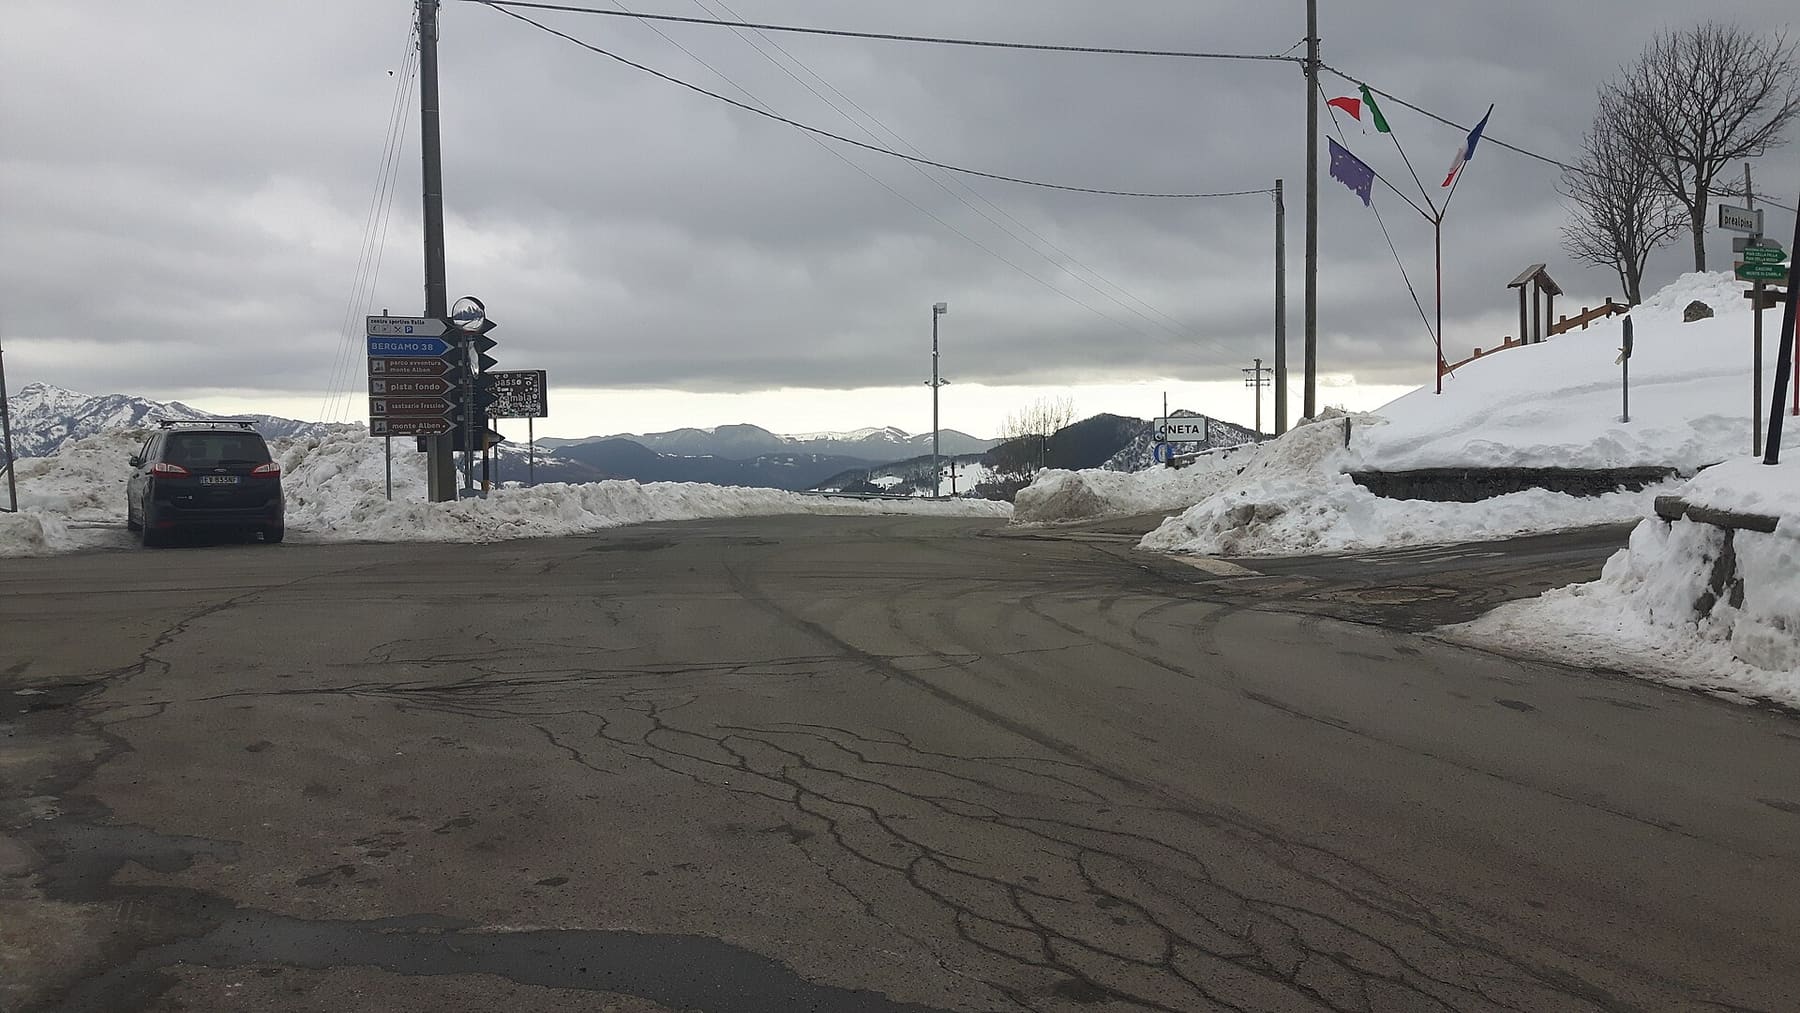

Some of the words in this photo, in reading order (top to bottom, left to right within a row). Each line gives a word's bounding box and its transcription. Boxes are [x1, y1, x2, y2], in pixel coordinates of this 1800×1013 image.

[1724, 215, 1753, 229] prealpina
[371, 342, 418, 351] BERGAMO
[421, 343, 433, 351] 38
[390, 383, 412, 391] pista
[415, 383, 441, 391] fondo
